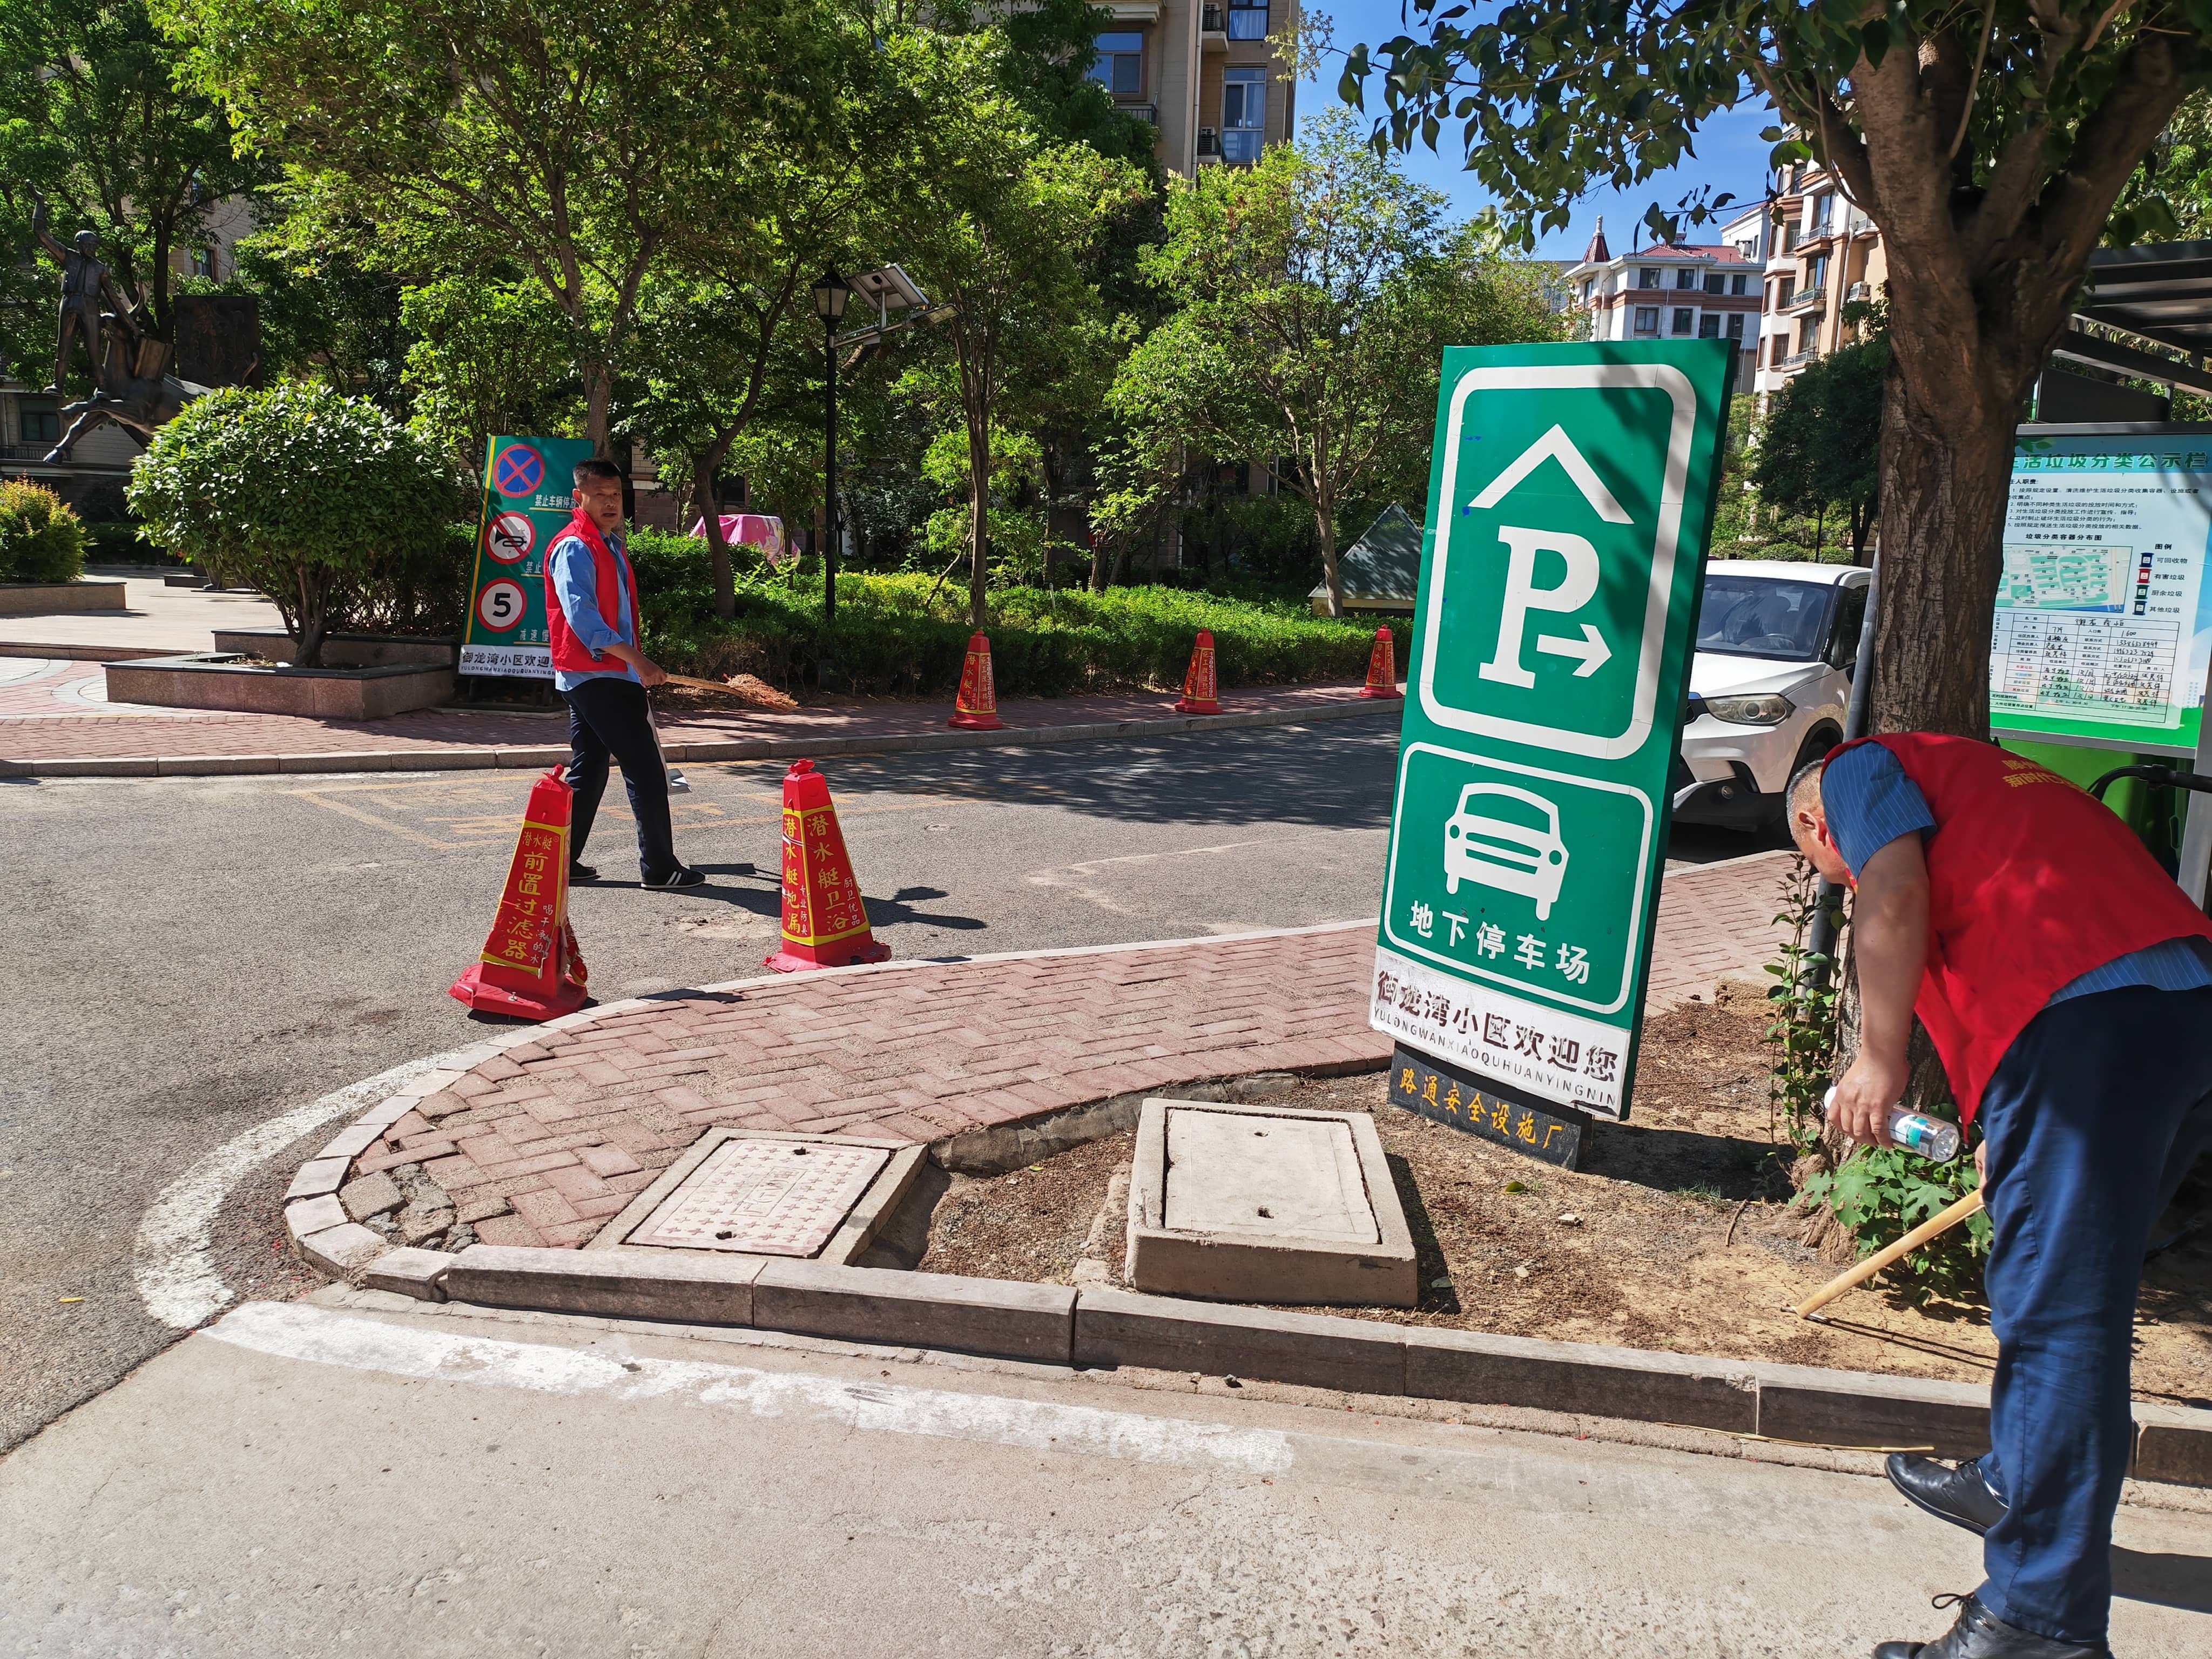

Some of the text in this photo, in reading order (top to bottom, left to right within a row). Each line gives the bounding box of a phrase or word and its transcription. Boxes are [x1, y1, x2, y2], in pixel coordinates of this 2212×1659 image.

[493, 592, 511, 617] 5
[1478, 525, 1600, 689] P
[462, 651, 554, 668] 御龙湾小区欢迎
[522, 831, 552, 851] 潜水艇
[784, 817, 801, 934] 潜水艇地漏
[807, 813, 850, 933] 潜水艇卫浴
[501, 852, 549, 960] 前置过滤器
[800, 884, 808, 935] 专业防臭
[844, 876, 860, 926] 厨卫优品
[1409, 900, 1590, 984] 地下停车场
[1377, 969, 1618, 1082] 御龙湾小区欢迎您
[1399, 1068, 1563, 1149] 路通安全设施厂
